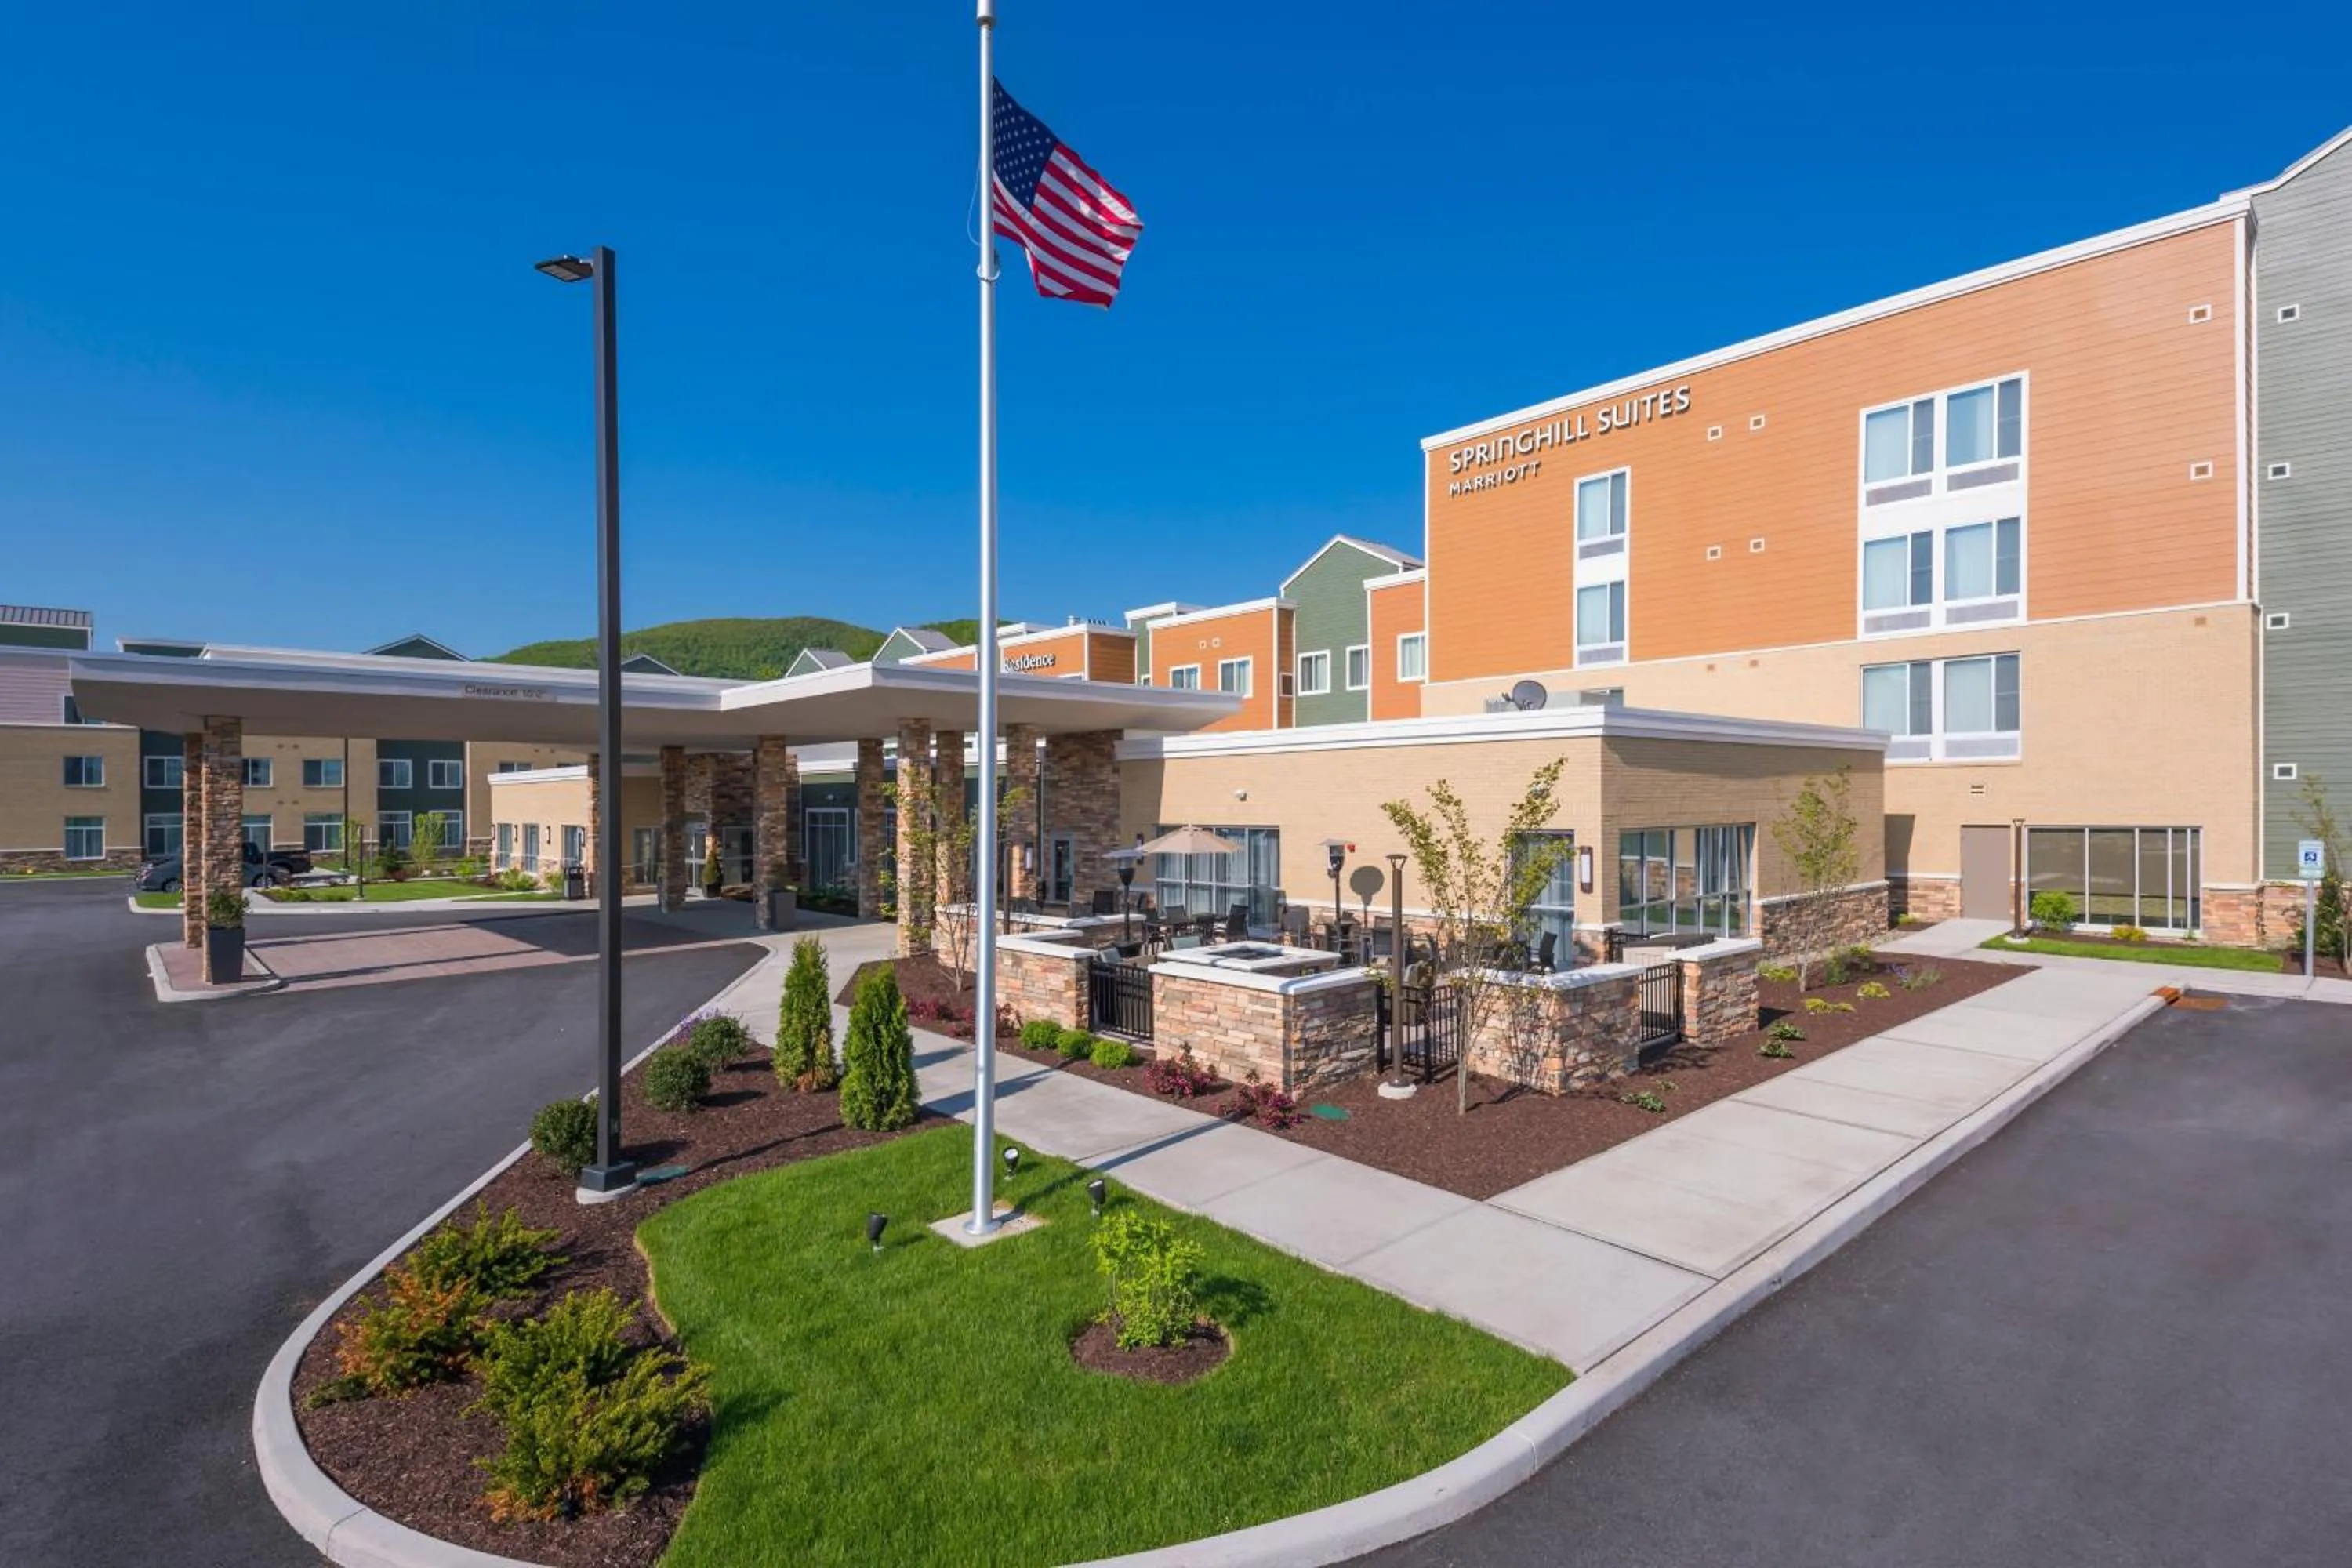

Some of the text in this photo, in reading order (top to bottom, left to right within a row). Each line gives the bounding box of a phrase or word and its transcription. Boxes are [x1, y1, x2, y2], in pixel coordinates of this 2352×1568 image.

[1449, 384, 1691, 473] SPRINGHILL SUITES
[1449, 460, 1541, 497] MARRIOTT
[465, 684, 517, 697] Clearance
